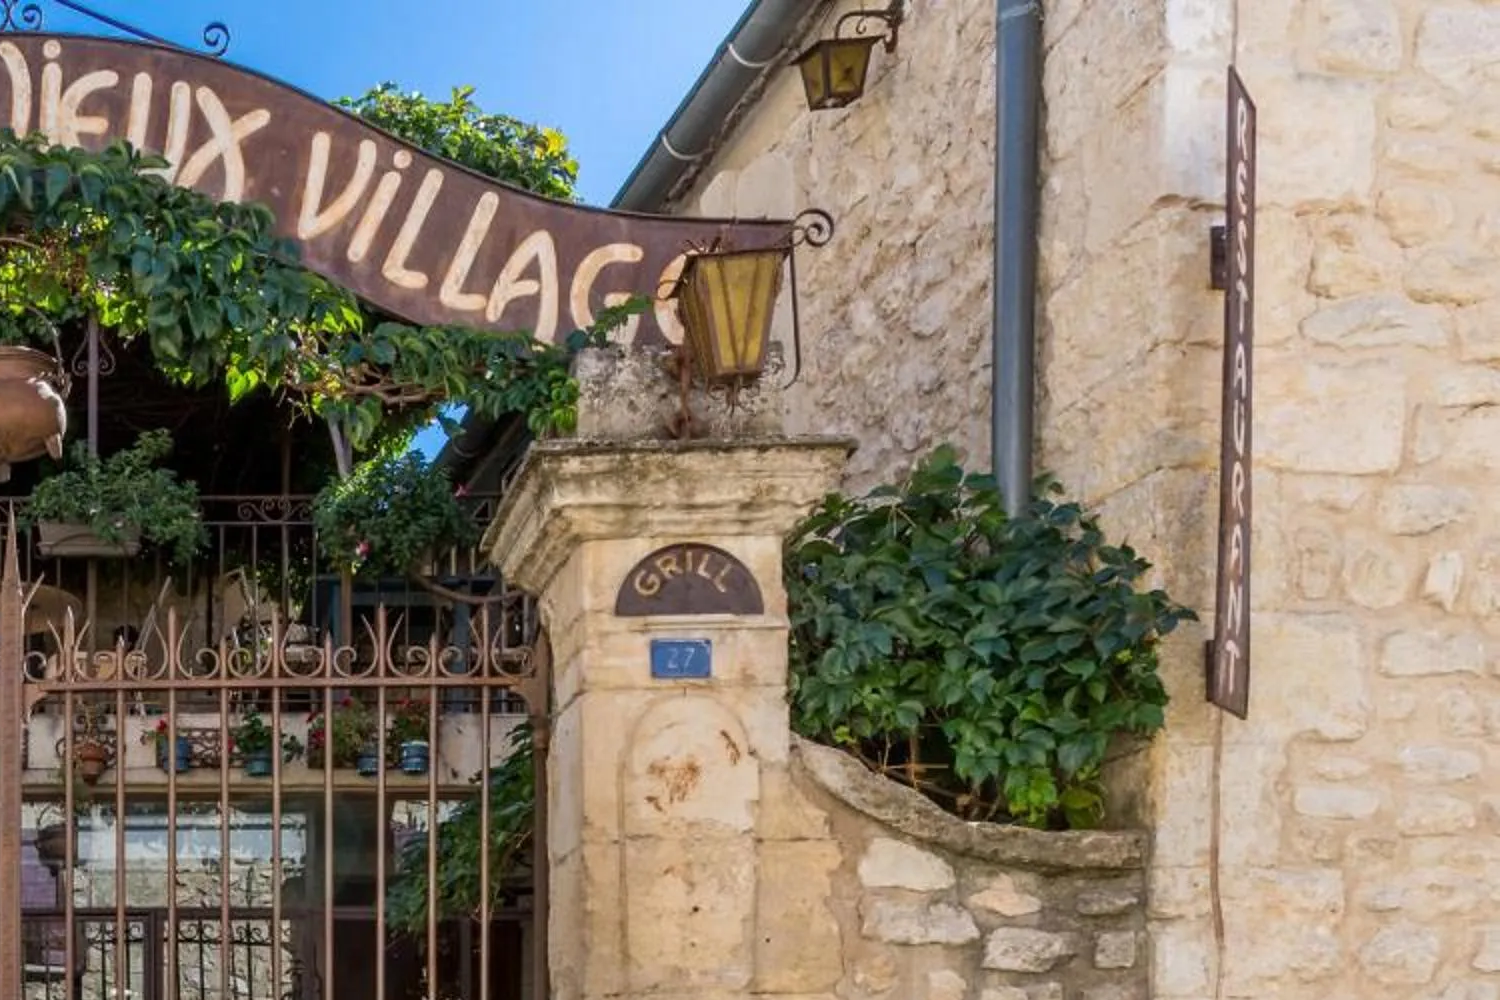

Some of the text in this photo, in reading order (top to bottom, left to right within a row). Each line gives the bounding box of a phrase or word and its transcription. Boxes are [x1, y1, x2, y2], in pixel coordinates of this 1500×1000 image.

[1224, 96, 1250, 695] RESTAURANT
[634, 551, 732, 596] GRILL
[666, 647, 696, 669] 27
